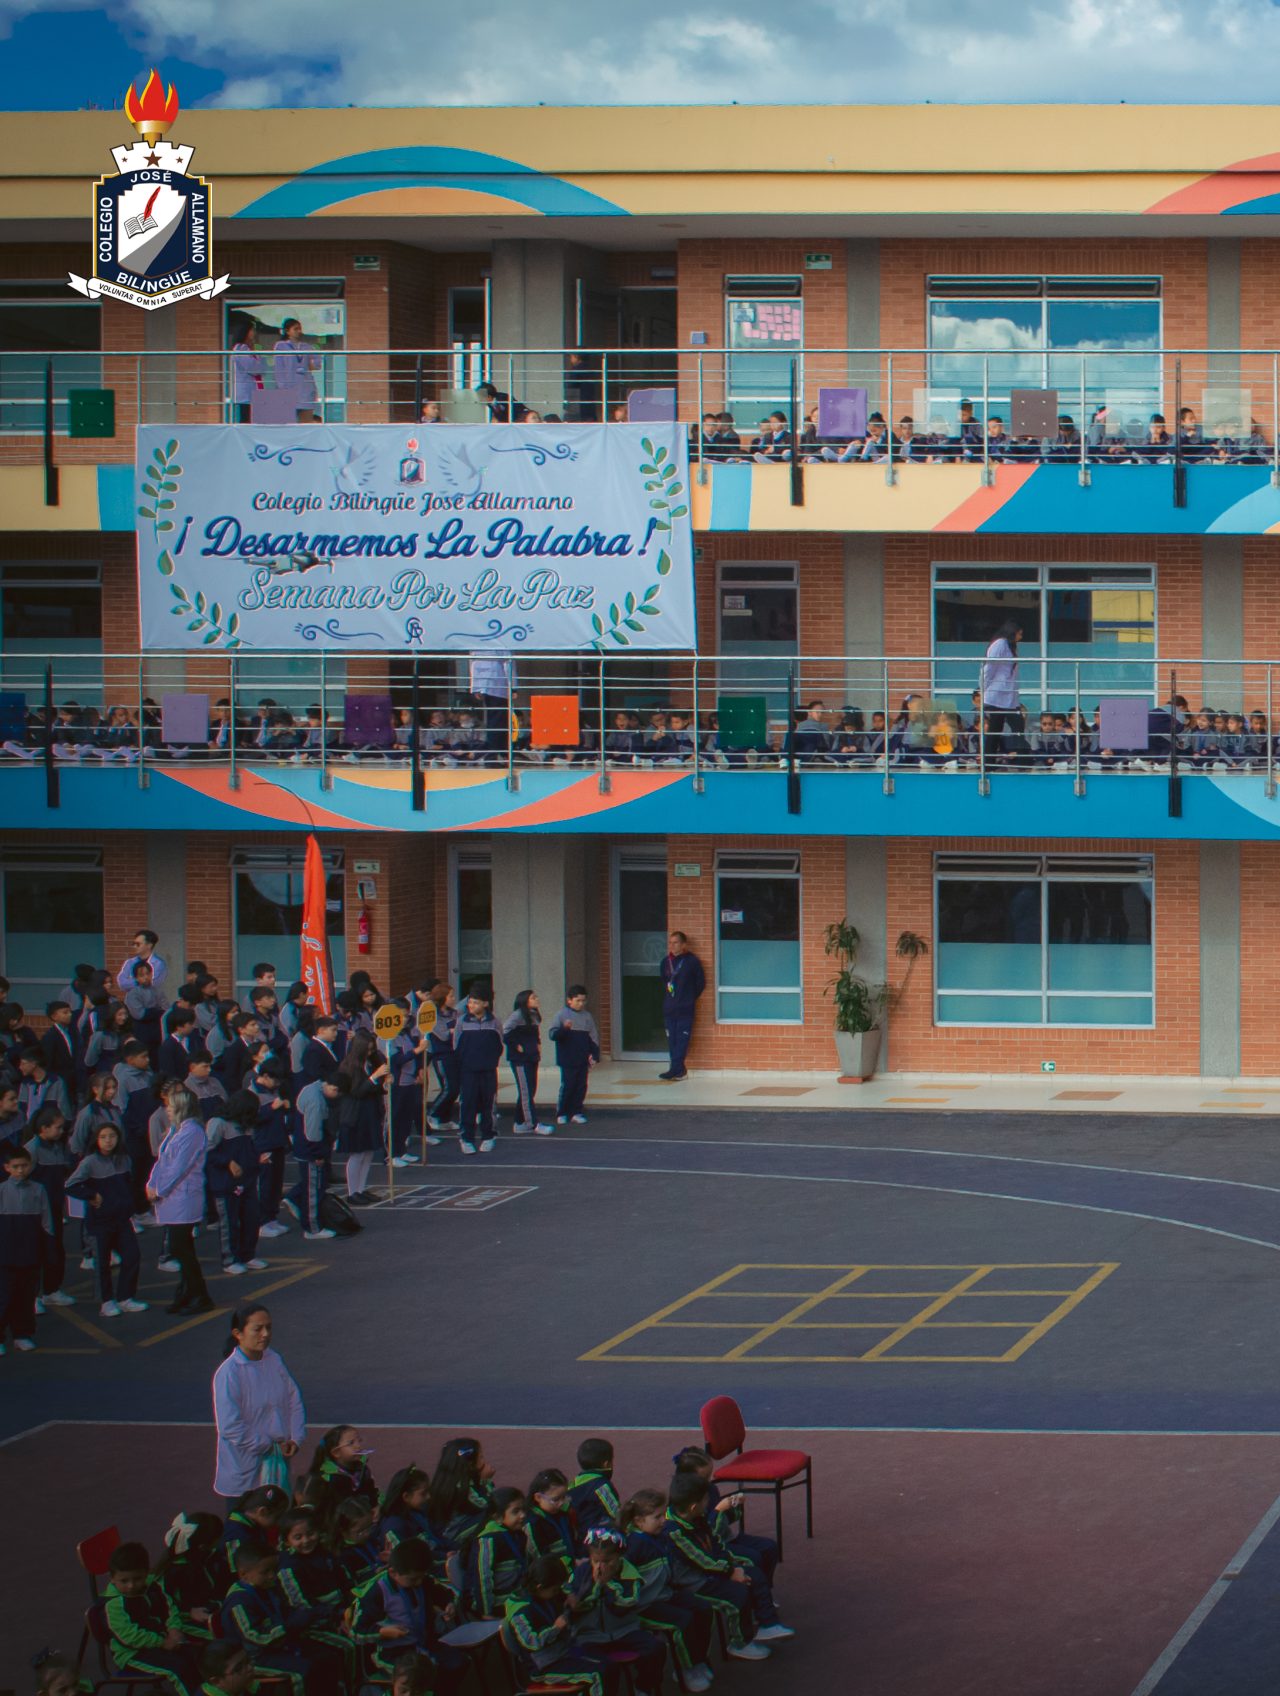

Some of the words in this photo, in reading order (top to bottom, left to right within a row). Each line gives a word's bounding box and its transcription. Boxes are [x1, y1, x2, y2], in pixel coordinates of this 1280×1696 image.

[252, 492, 323, 515] Colegio
[329, 492, 416, 515] Bilingüe
[419, 492, 465, 517] José
[466, 492, 575, 511] Allamano
[201, 515, 419, 557] Desarmemos
[424, 518, 478, 559] La
[482, 517, 634, 558] Palabra
[238, 569, 385, 611] Semana
[386, 568, 456, 611] Por
[458, 568, 517, 611] La
[518, 568, 595, 611] Paz
[376, 1014, 402, 1029] 803
